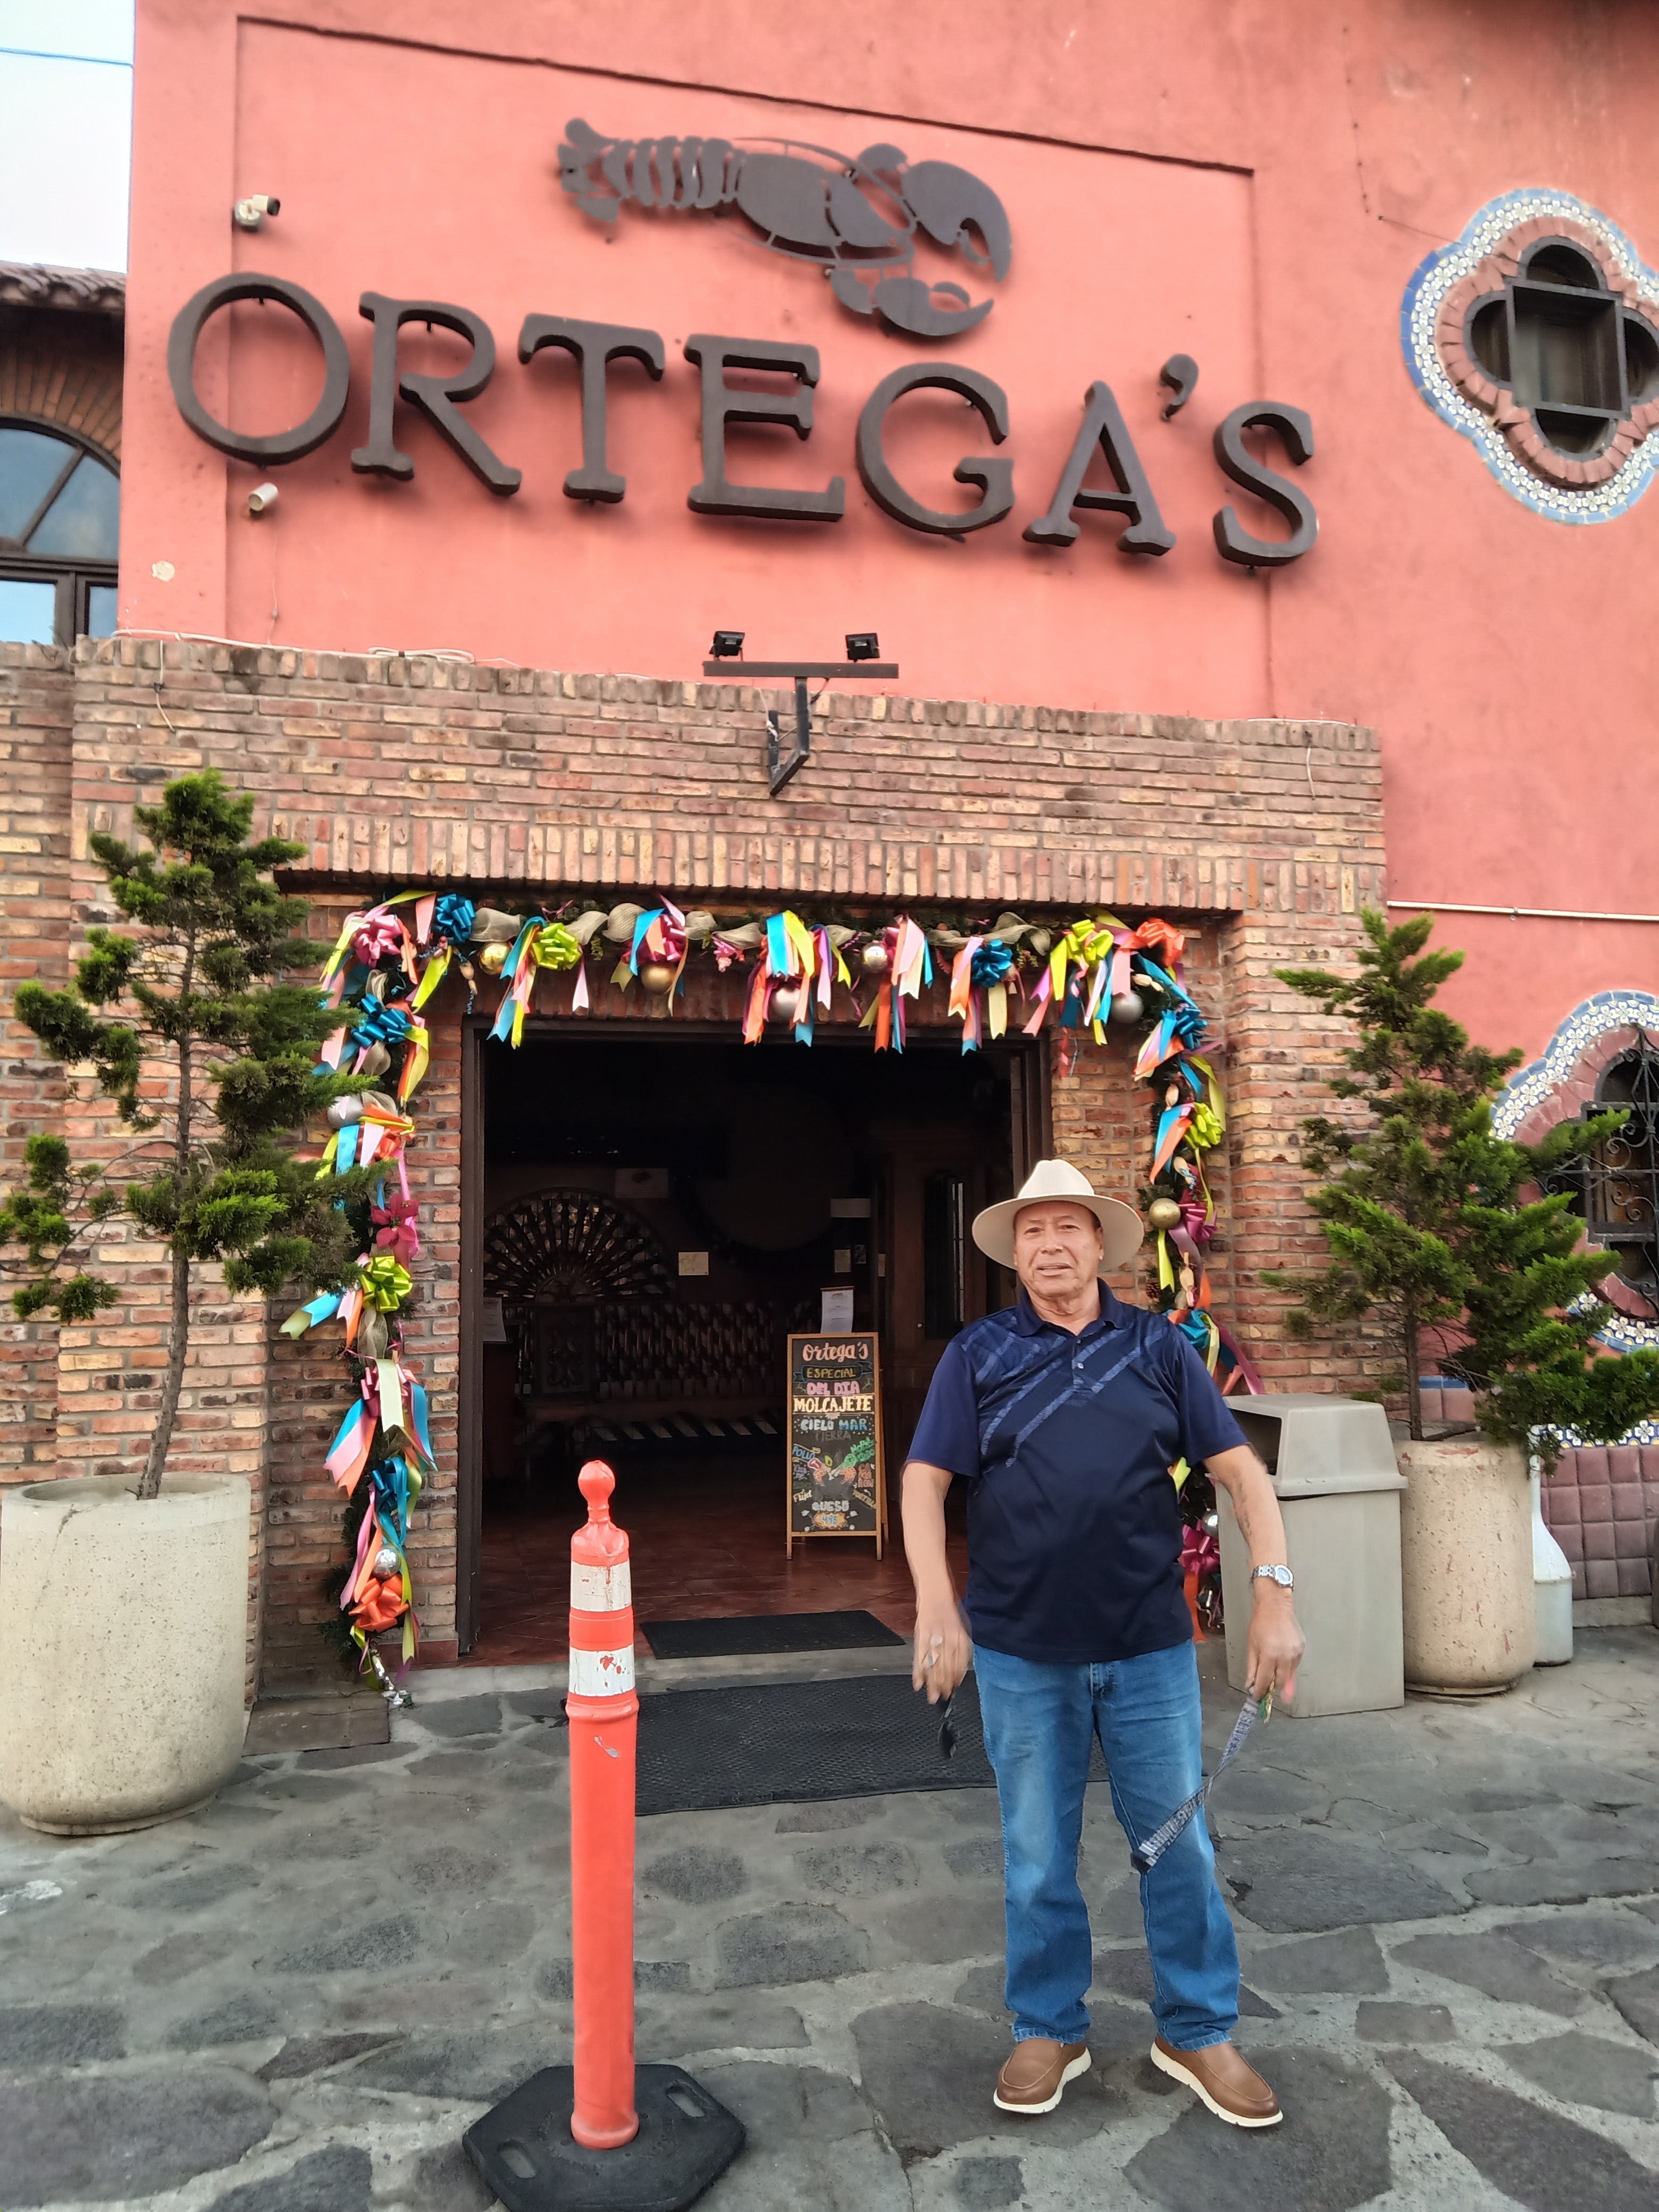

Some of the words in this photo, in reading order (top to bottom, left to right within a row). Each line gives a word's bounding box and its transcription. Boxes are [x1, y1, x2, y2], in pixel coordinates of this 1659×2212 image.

[167, 272, 1318, 567] ORTEGA'S
[802, 1342, 868, 1362] Ortega's
[807, 1368, 856, 1378] ESPECIAL
[807, 1382, 831, 1396] DEL
[834, 1381, 860, 1395] DIA
[793, 1395, 873, 1412] MOLCAJETE
[801, 1419, 834, 1430] CIELO
[839, 1418, 868, 1430] MAR
[816, 1431, 851, 1440] TIERRA
[793, 1446, 815, 1459] POLLO
[812, 1500, 849, 1512] QUESO
[822, 1515, 838, 1524] 495
